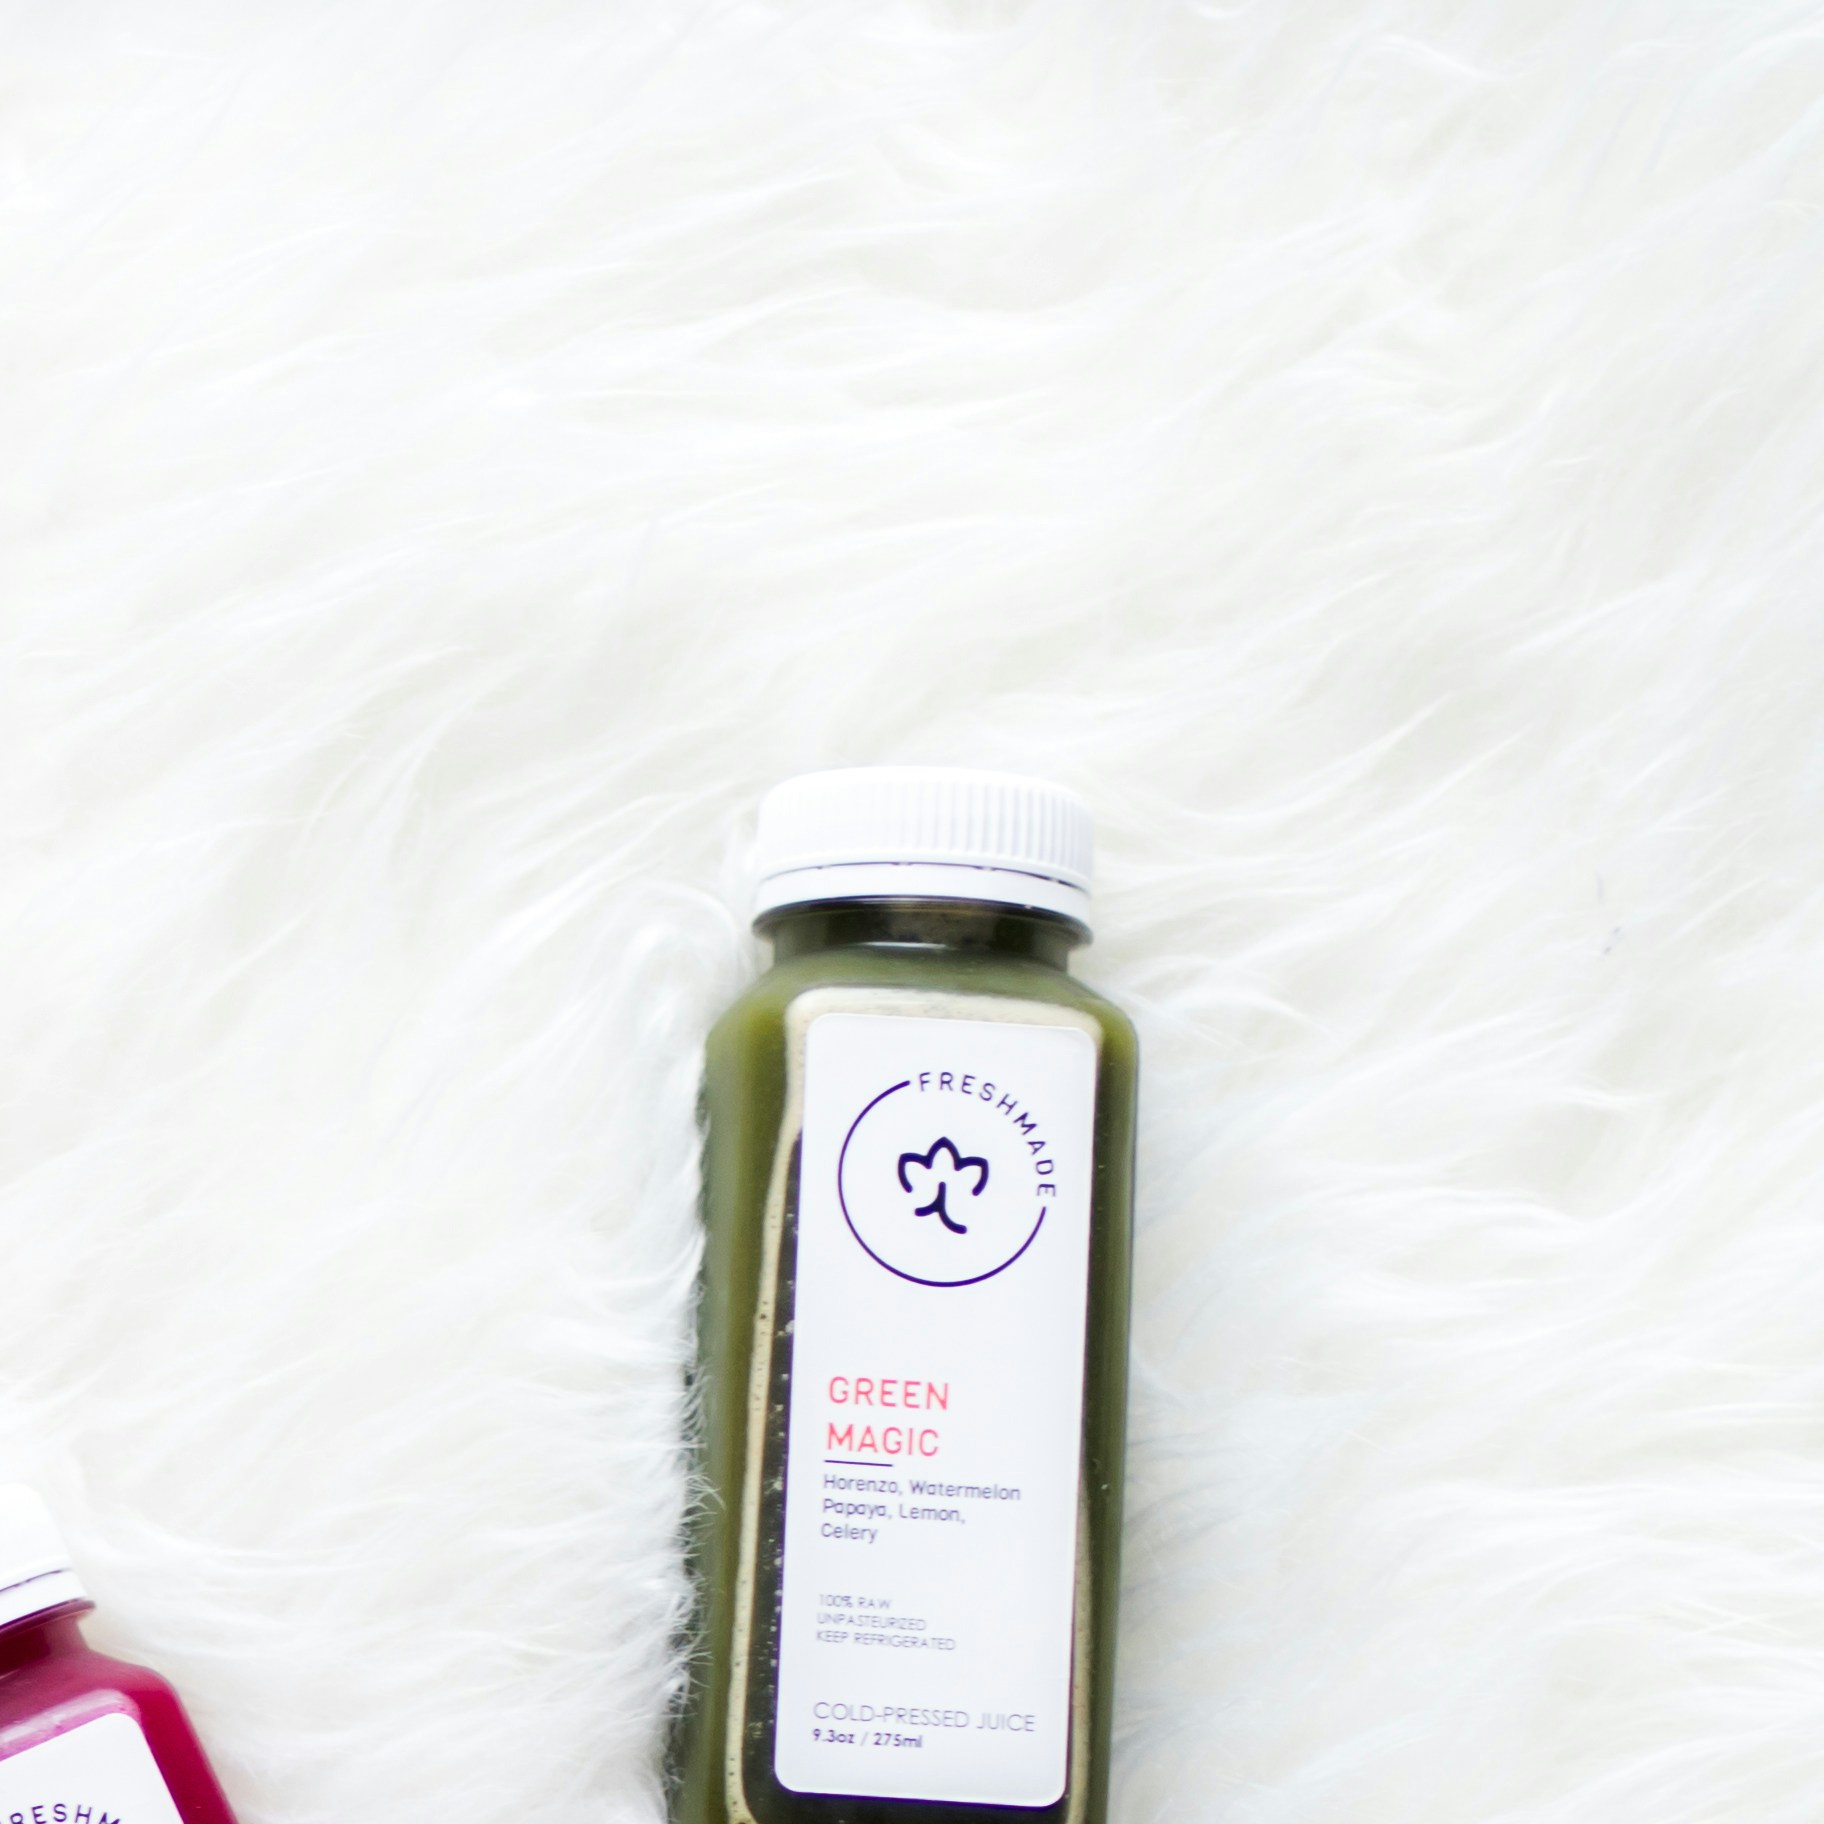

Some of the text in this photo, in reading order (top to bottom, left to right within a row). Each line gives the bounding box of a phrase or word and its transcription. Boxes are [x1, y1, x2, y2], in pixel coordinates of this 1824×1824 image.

[917, 1071, 1057, 1198] FRESHMADE
[829, 1376, 948, 1410] GREEN
[827, 1423, 939, 1457] MAGIC
[909, 1480, 1021, 1500] Watermelon
[823, 1498, 965, 1524] Papaya, Lemon,
[821, 1523, 878, 1544] Celery
[820, 1594, 891, 1609] 100% RAW
[817, 1613, 927, 1631] UNPASTEURIZED
[816, 1630, 956, 1650] KEEP REFRIGERATED
[813, 1702, 1035, 1732] COLD-PRESSED JUICE
[813, 1728, 855, 1744] 9.3oz
[873, 1732, 922, 1748] 275ml
